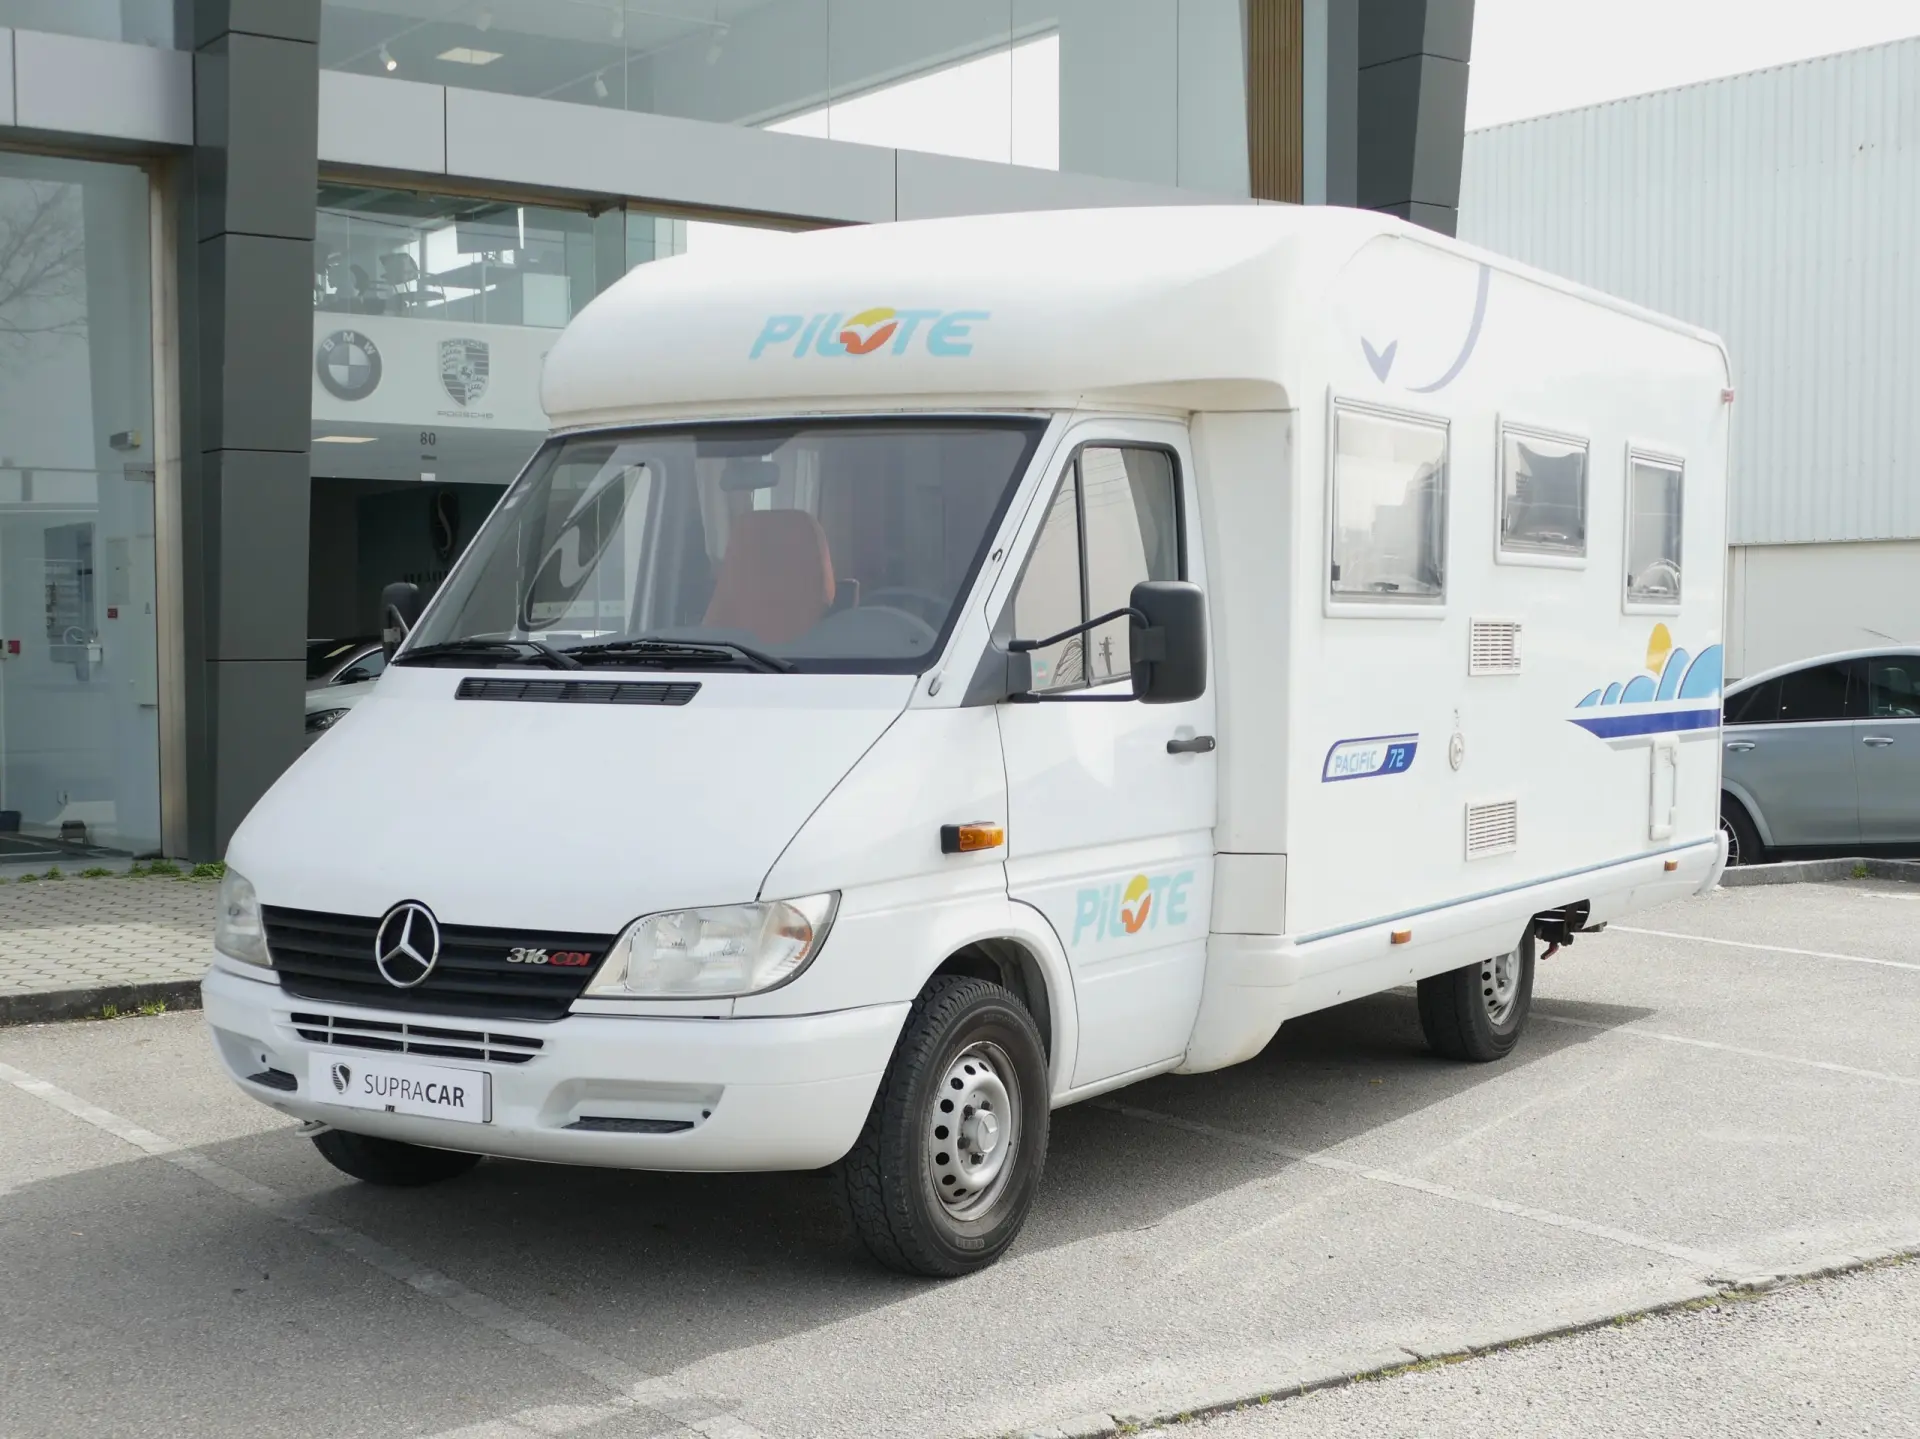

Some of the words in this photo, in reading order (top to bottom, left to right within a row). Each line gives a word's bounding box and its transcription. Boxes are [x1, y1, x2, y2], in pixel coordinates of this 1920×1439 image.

[323, 332, 376, 355] BMW
[748, 307, 991, 360] PILOTE
[437, 410, 494, 419] PORSCHE
[420, 432, 436, 446] 80
[1388, 748, 1404, 768] 72
[364, 1073, 464, 1108] SUPRACAR
